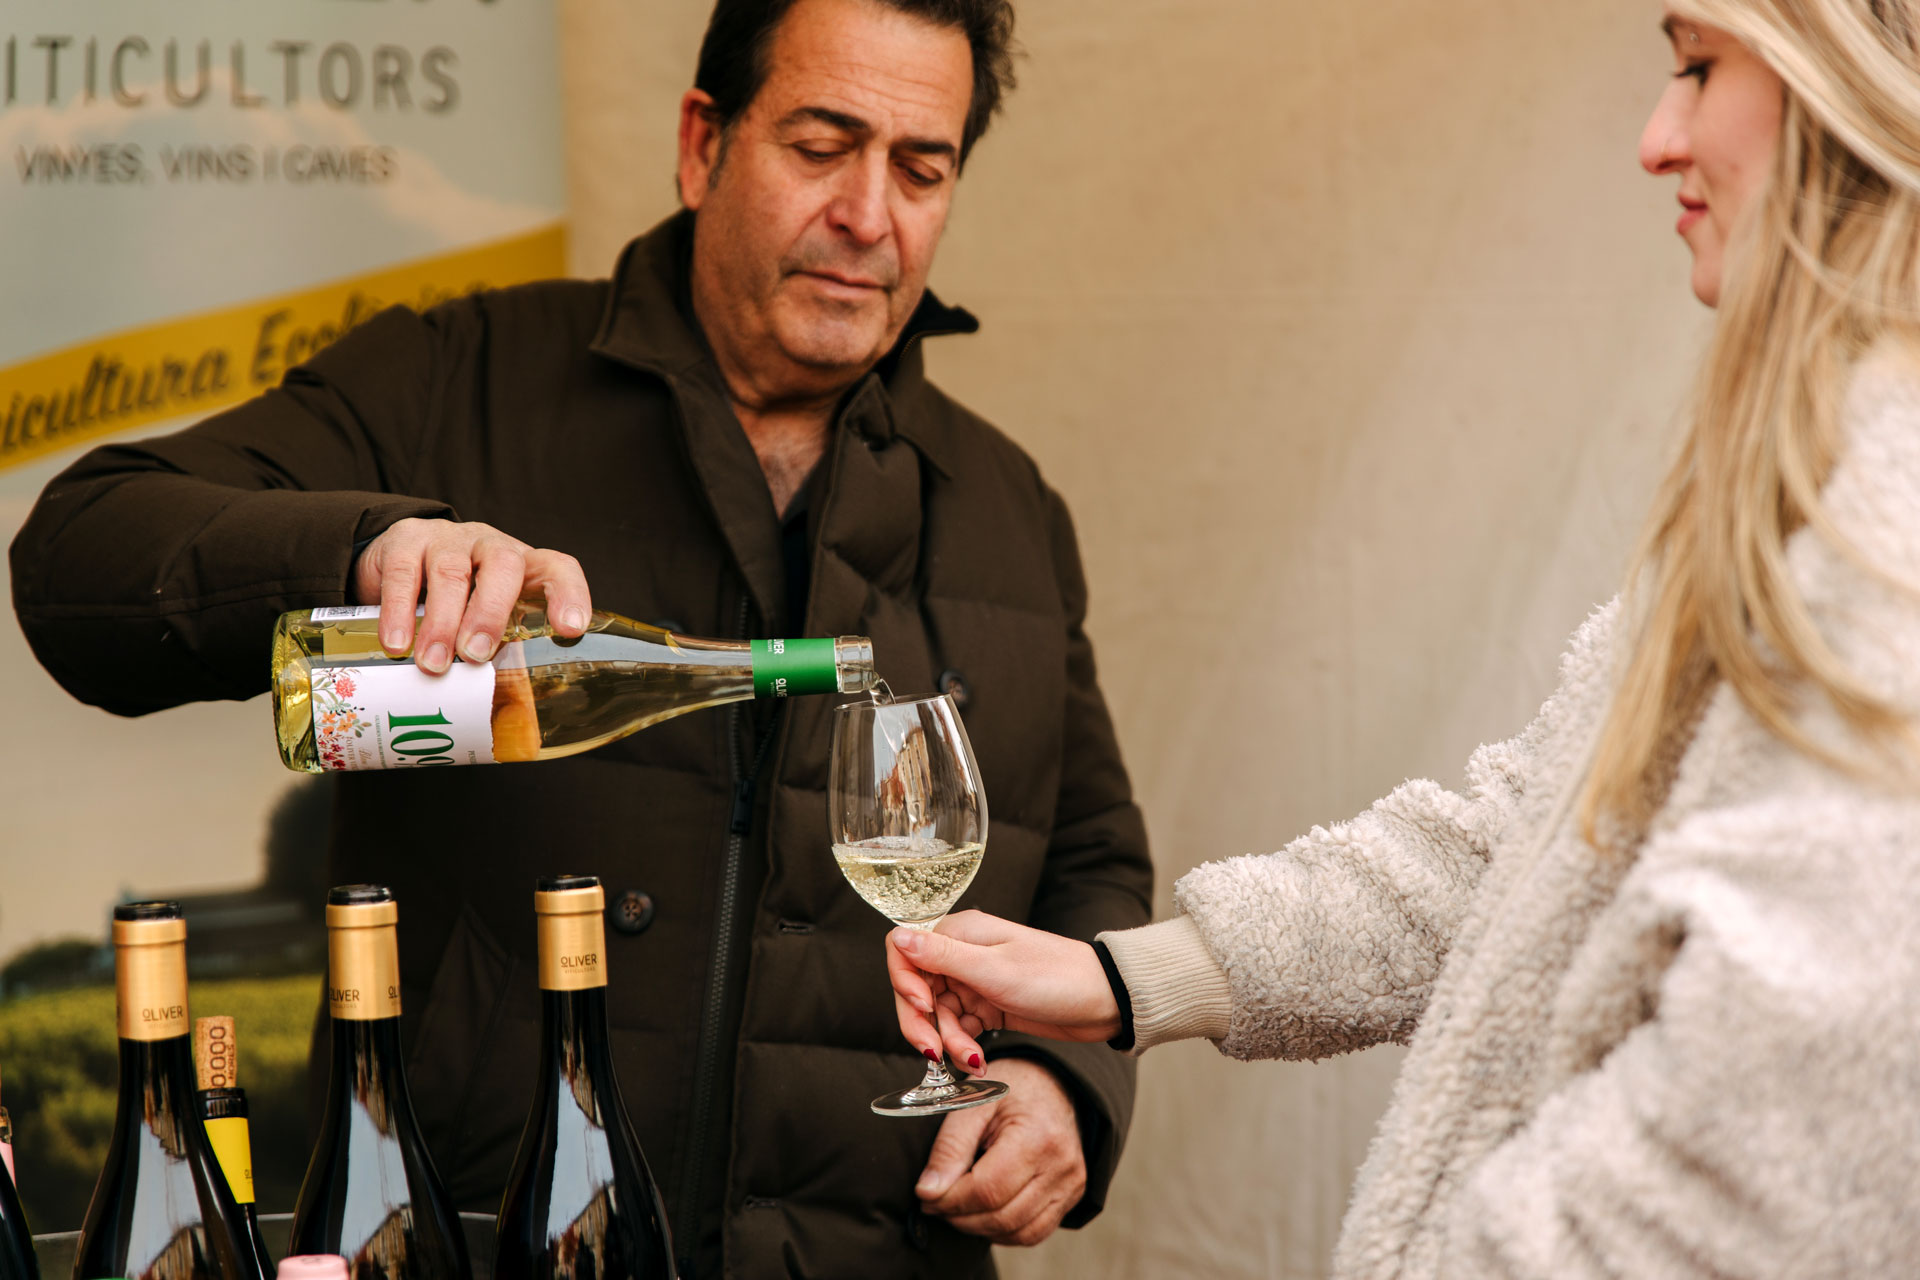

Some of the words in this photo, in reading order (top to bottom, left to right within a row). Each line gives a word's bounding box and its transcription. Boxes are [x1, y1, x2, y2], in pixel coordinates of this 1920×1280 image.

[159, 143, 257, 185] VINS
[283, 144, 398, 186] CAVES
[560, 953, 598, 968] OLIVER
[142, 1005, 184, 1021] OLIVER
